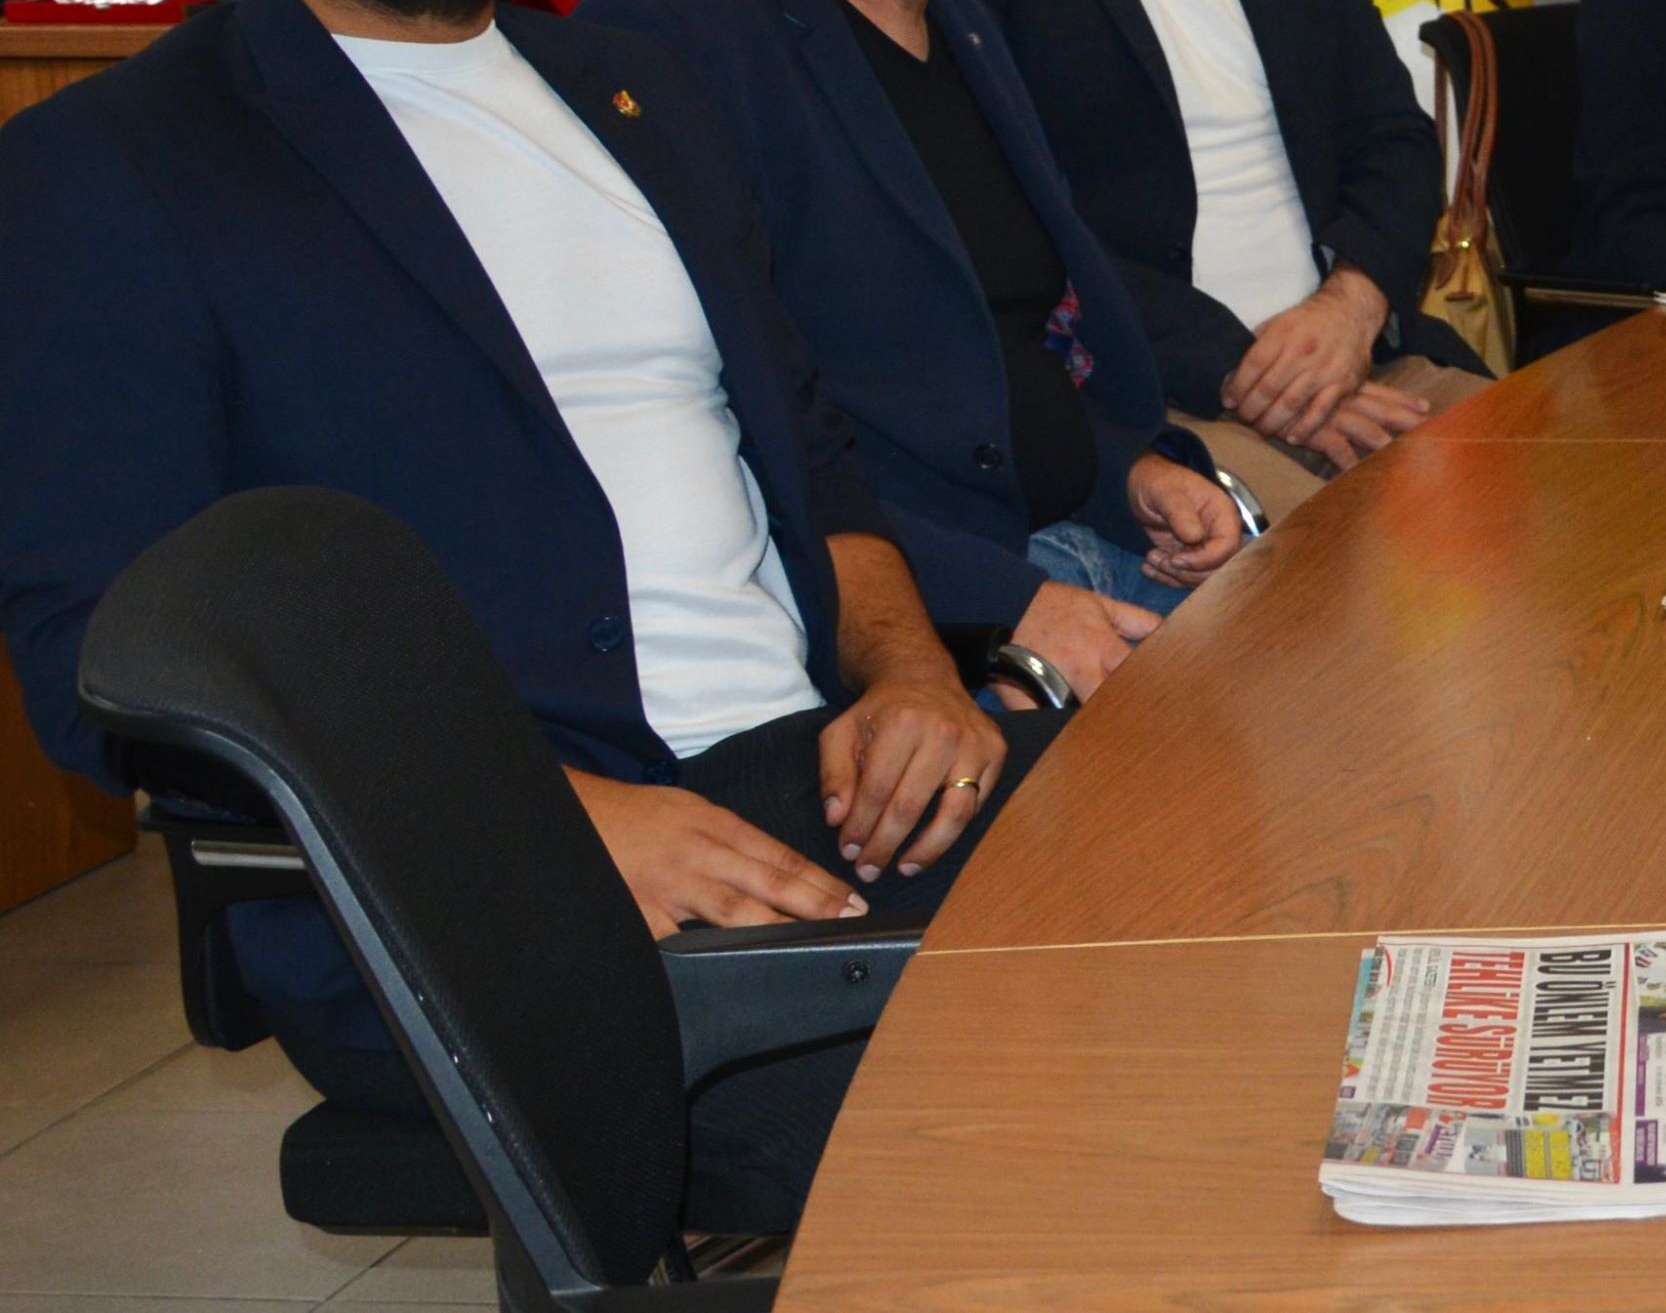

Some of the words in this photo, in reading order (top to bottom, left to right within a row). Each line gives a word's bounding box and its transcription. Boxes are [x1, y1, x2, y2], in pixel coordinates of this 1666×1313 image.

[1442, 952, 1525, 1021] TEHLİKE
[1537, 949, 1612, 974] BU
[1532, 980, 1616, 1038] ÖNLEM
[1426, 1024, 1517, 1110] SÜRÜYOR
[1524, 1042, 1605, 1111] YETMEZ
